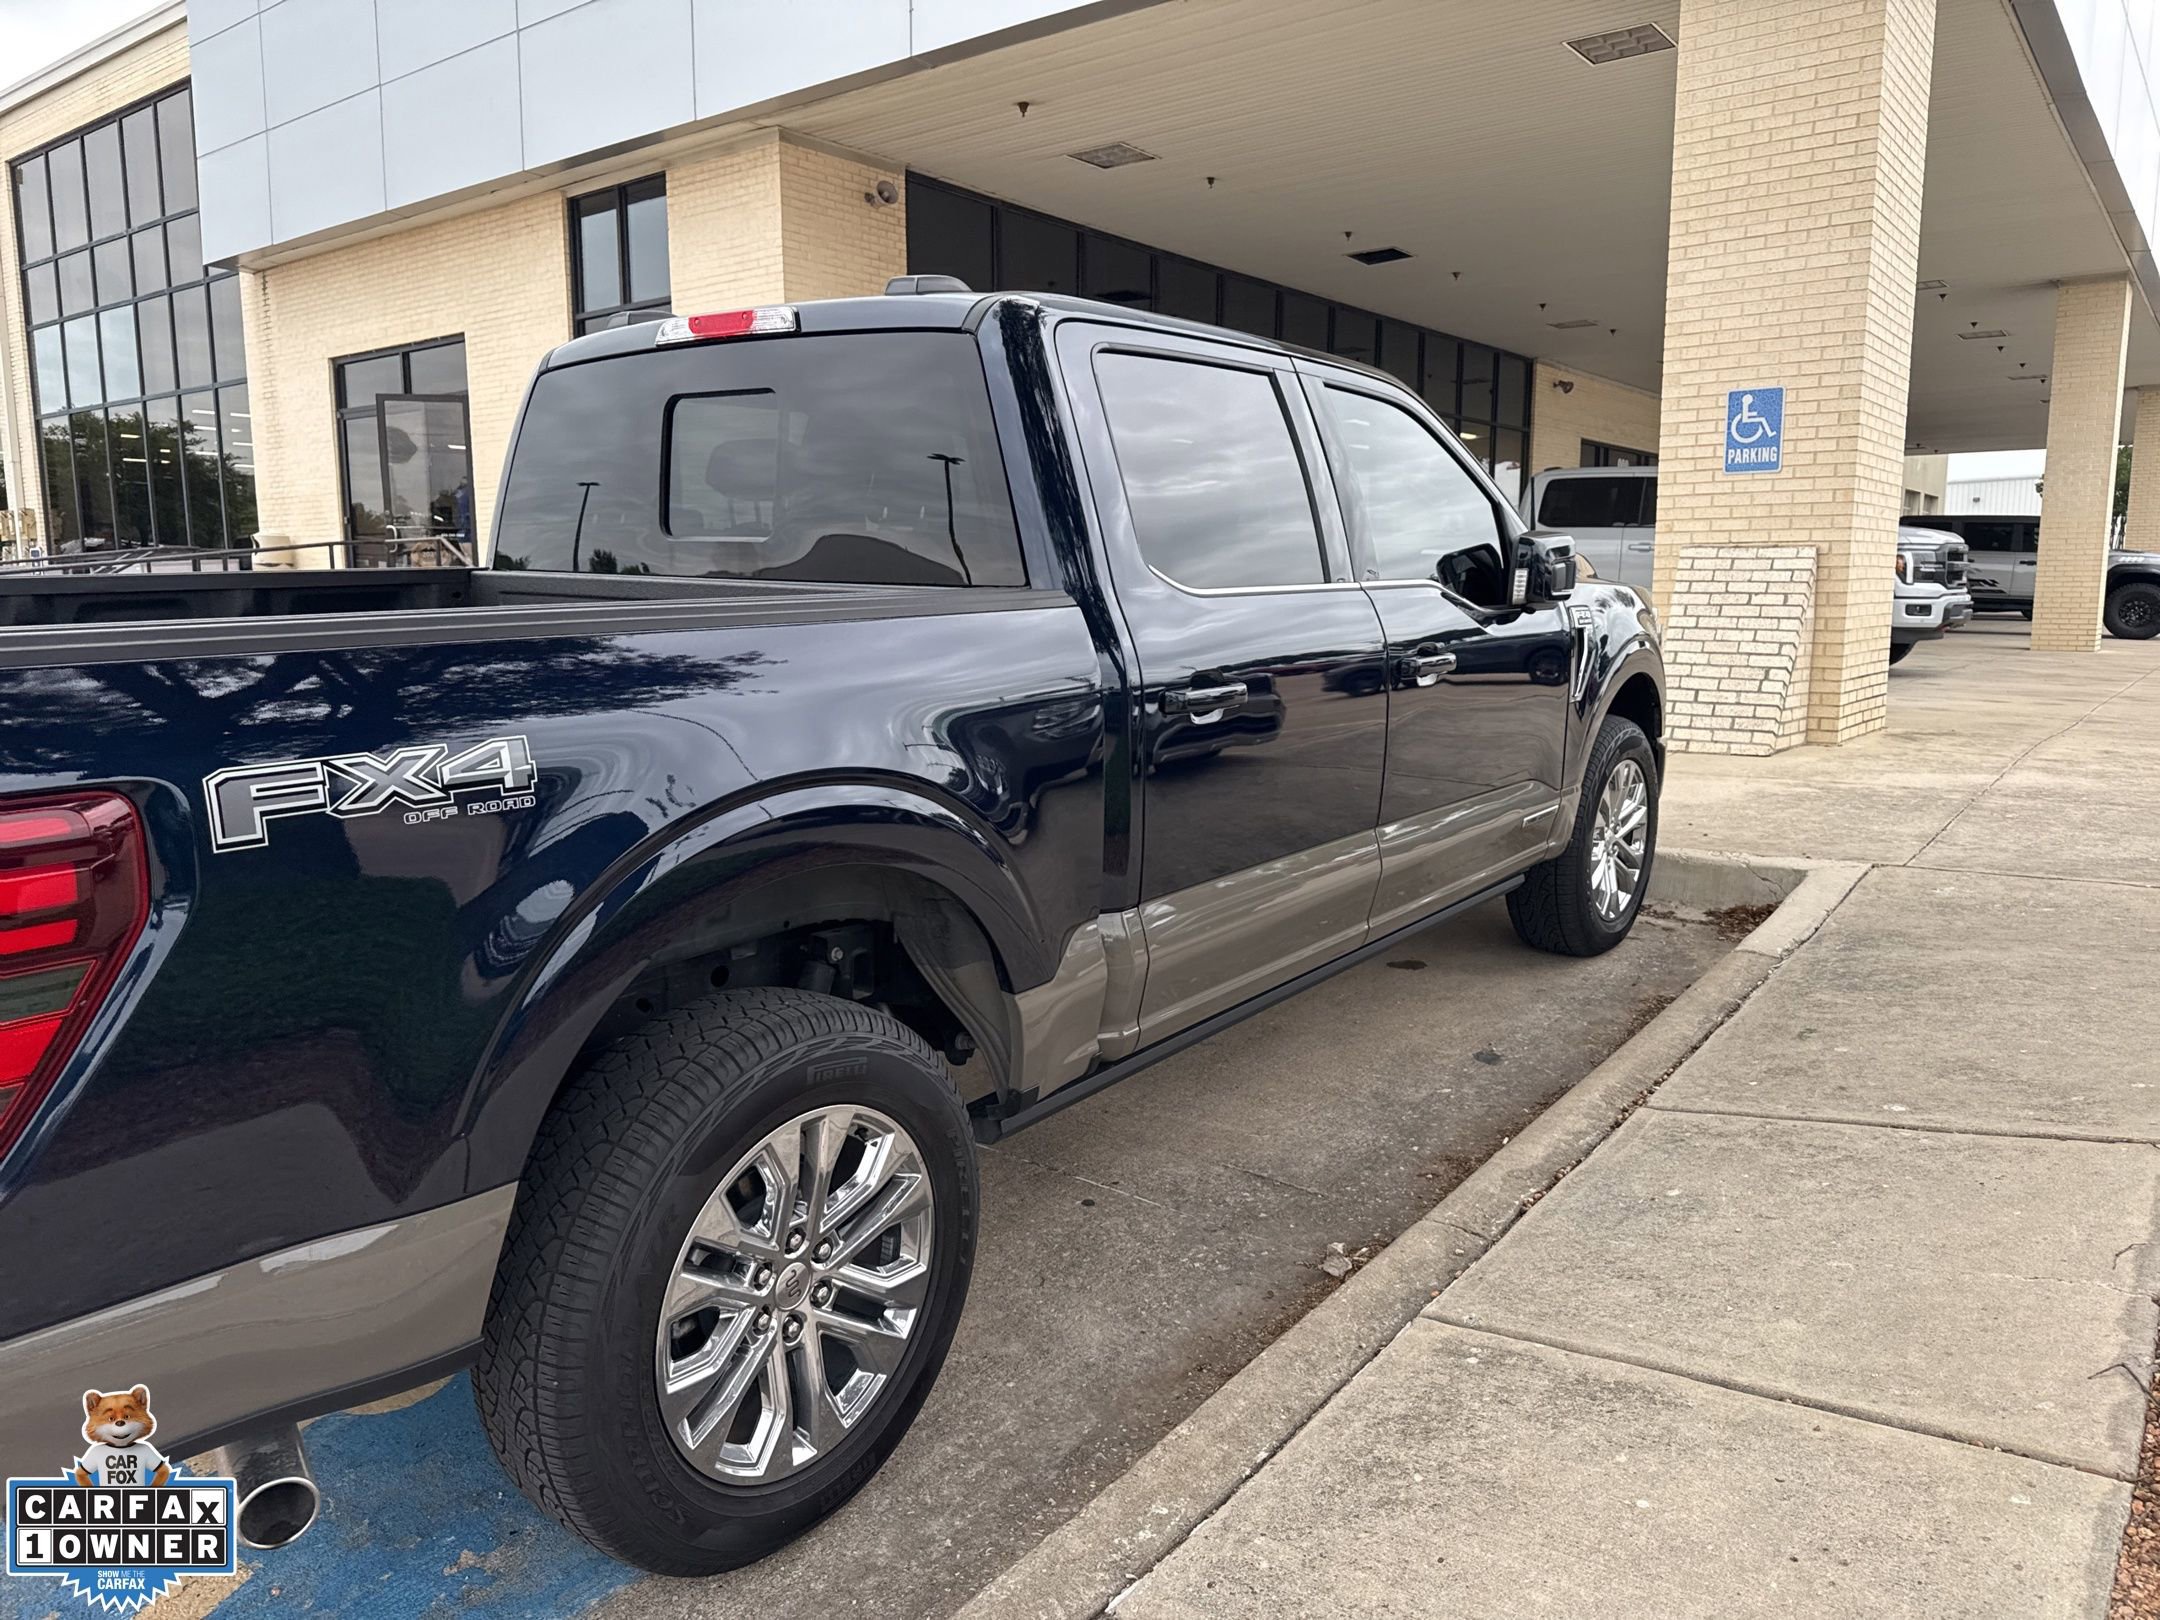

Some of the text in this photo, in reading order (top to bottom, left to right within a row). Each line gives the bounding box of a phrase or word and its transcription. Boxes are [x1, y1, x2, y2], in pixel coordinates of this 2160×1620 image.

[1727, 446, 1778, 465] PARKING
[202, 735, 538, 854] FX4
[404, 796, 536, 825] OFF ROAD
